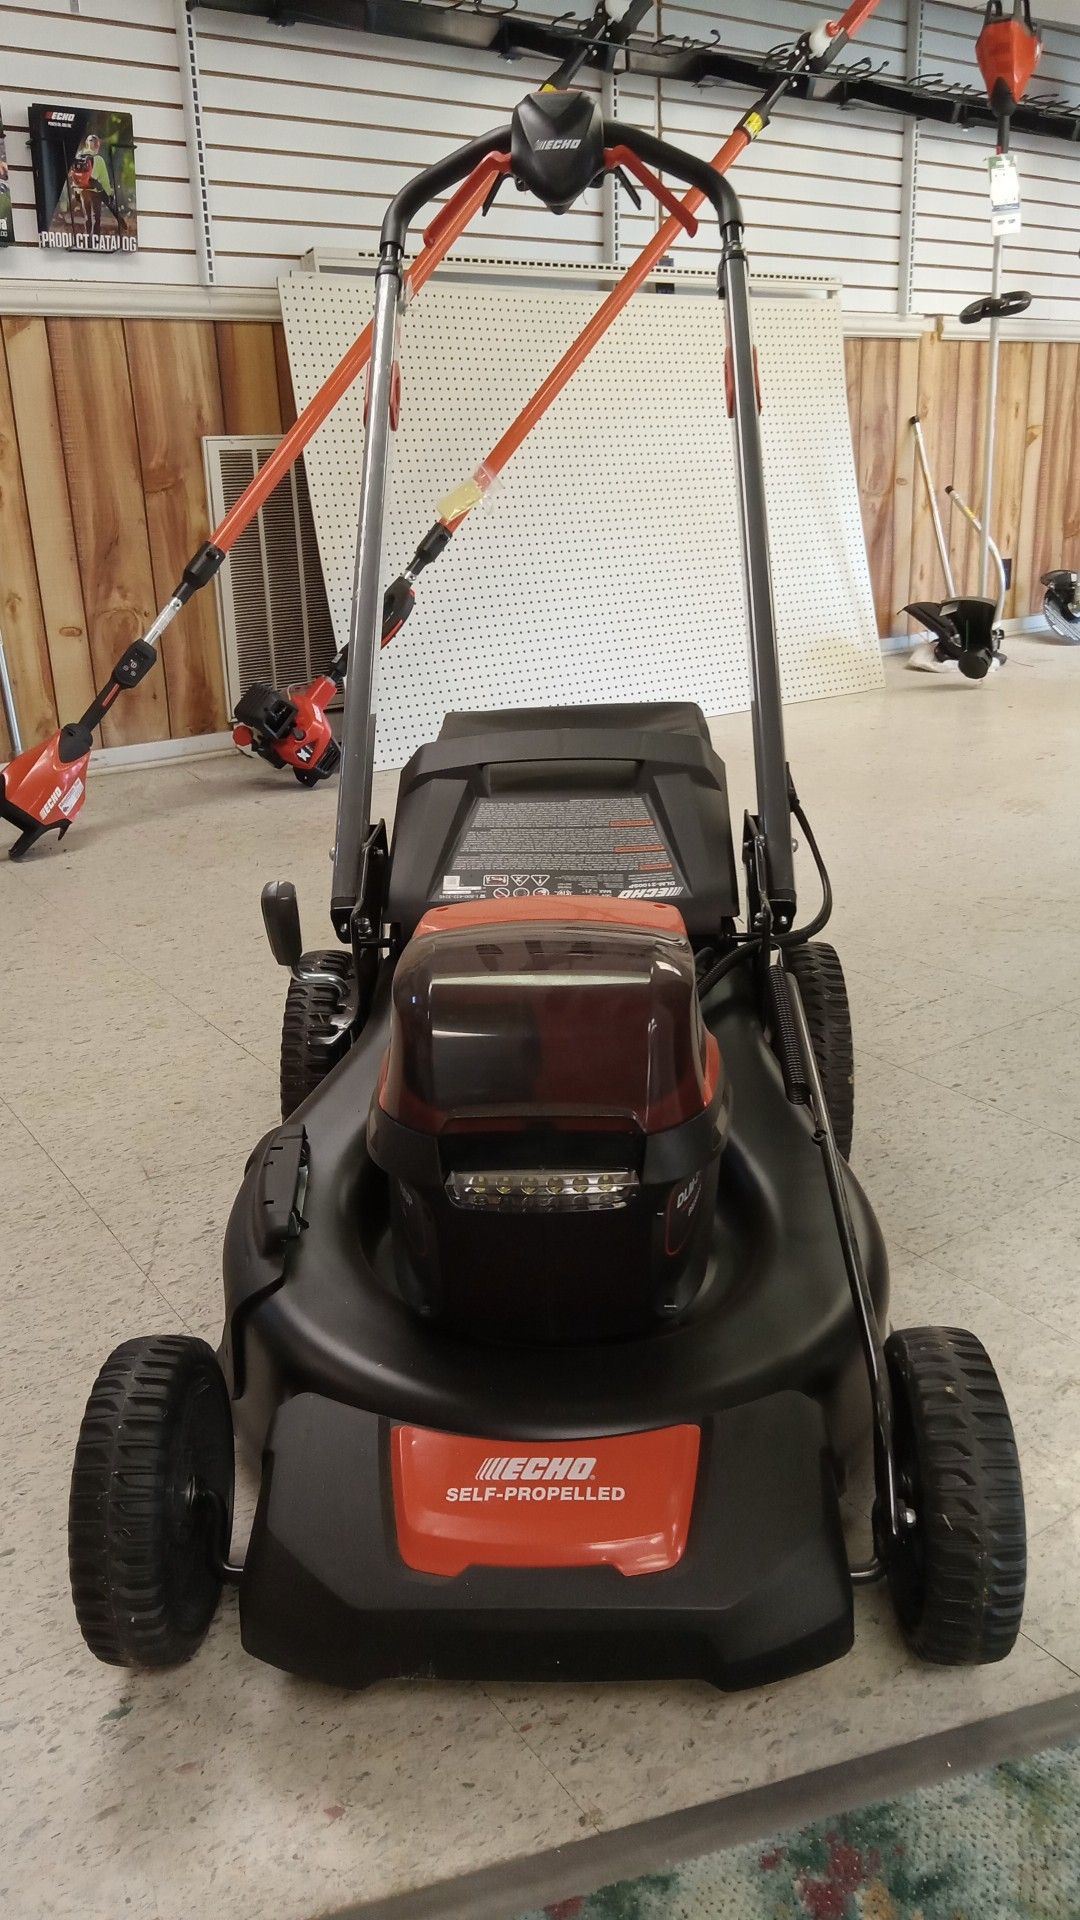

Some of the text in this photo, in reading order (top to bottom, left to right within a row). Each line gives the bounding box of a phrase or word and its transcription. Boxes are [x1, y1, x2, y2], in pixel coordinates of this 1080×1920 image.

[52, 112, 75, 121] ECHO
[543, 139, 582, 150] ECHO
[43, 786, 62, 817] ECHO
[617, 886, 671, 899] ECHO
[500, 1457, 597, 1480] ECHO
[445, 1486, 626, 1502] SELF-PROPELLED
